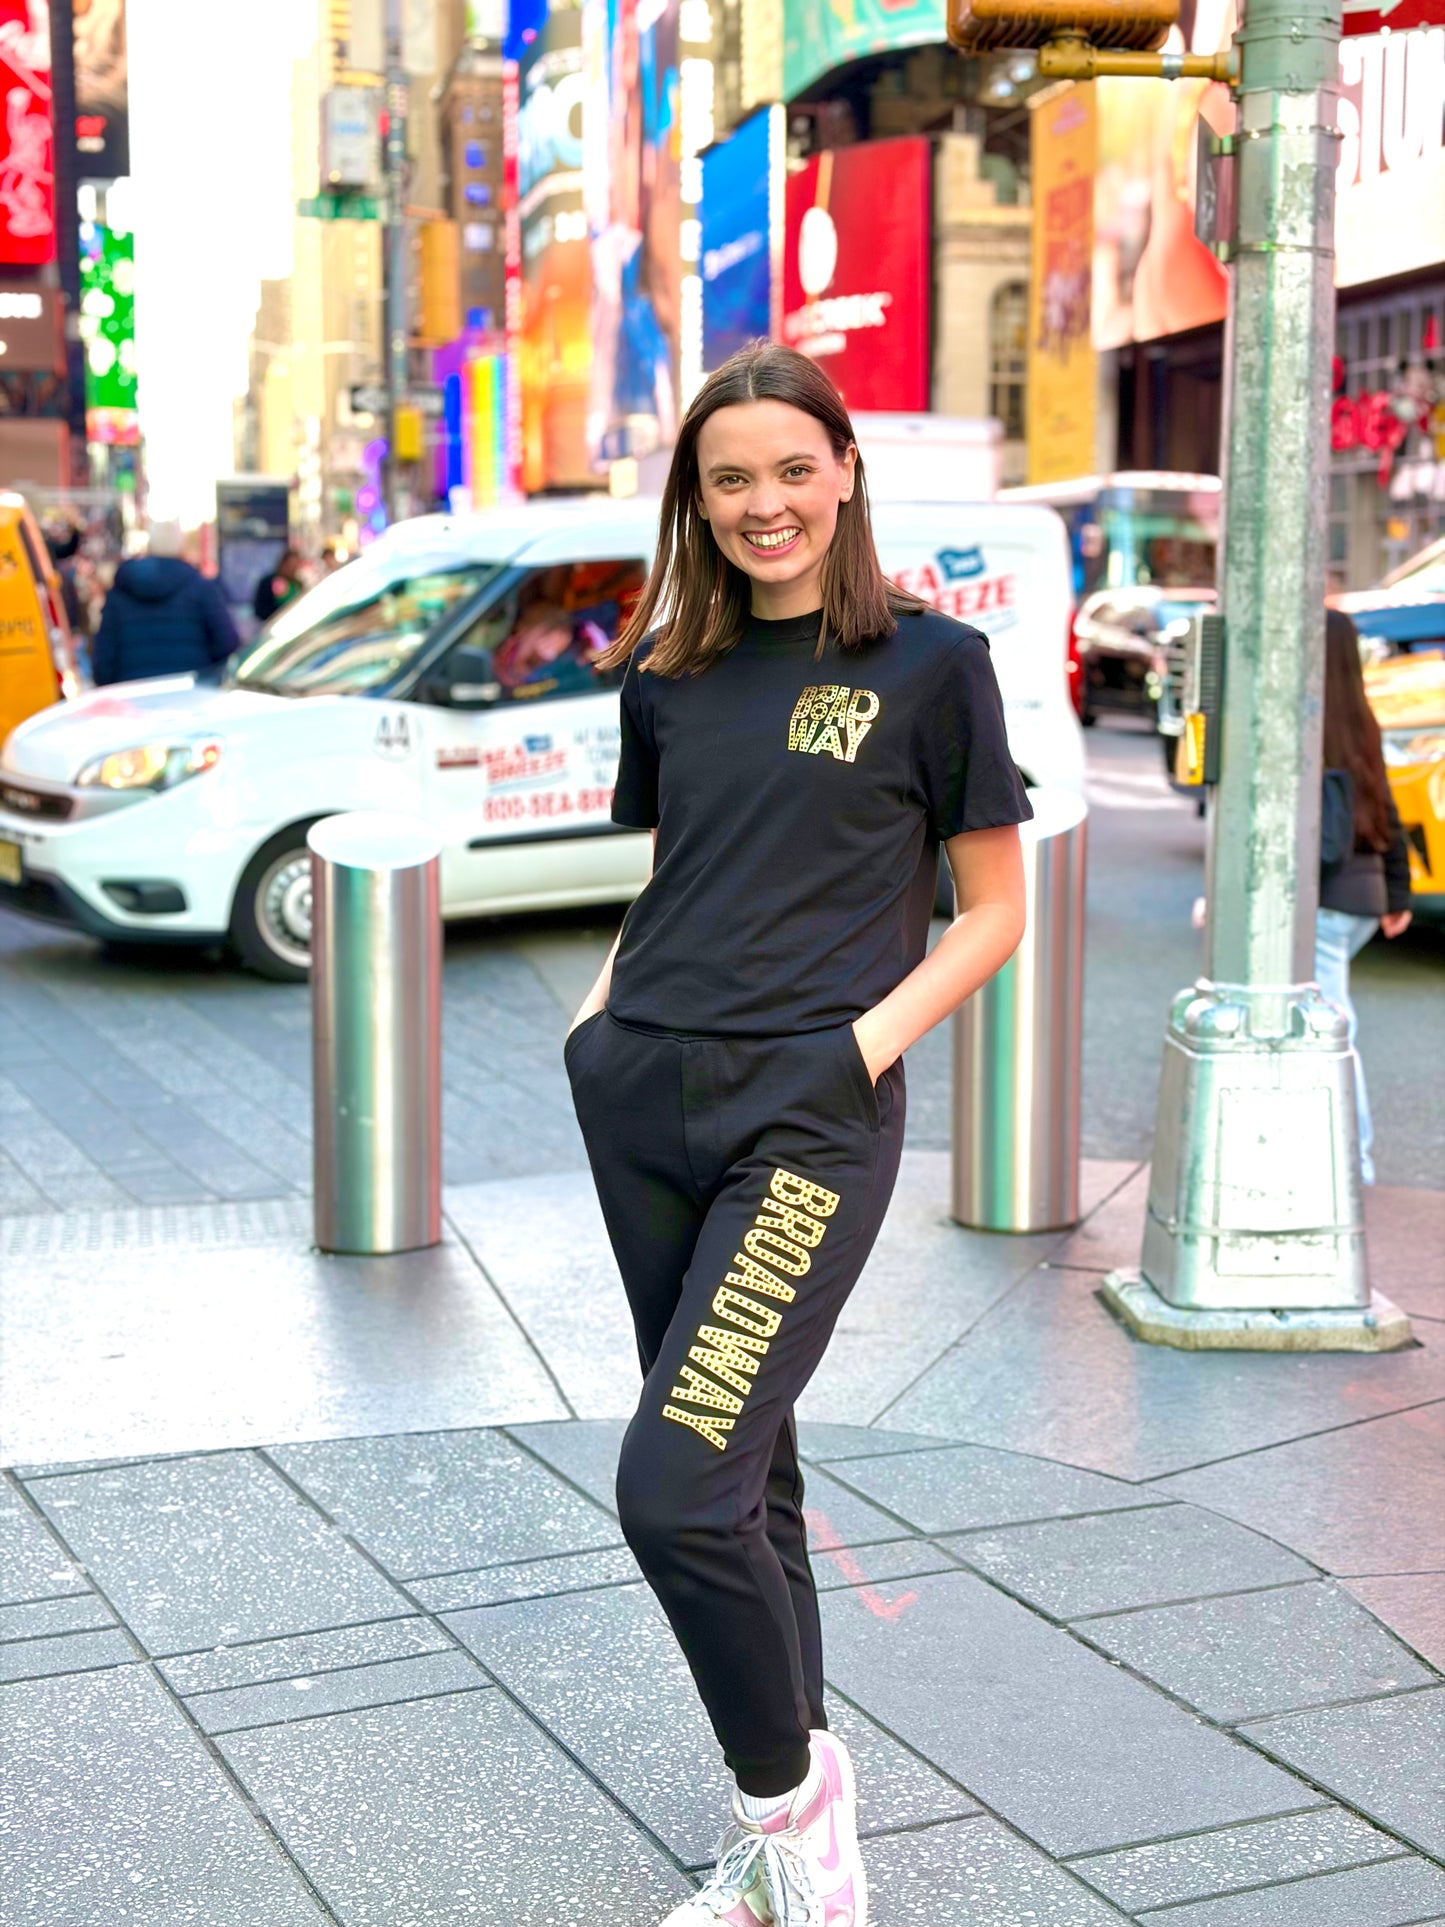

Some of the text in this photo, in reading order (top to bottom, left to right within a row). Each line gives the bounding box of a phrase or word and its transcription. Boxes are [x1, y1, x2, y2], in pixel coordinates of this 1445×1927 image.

[791, 685, 880, 728] BROAD
[788, 718, 873, 763] WAY
[662, 1168, 840, 1451] BROADWAY
